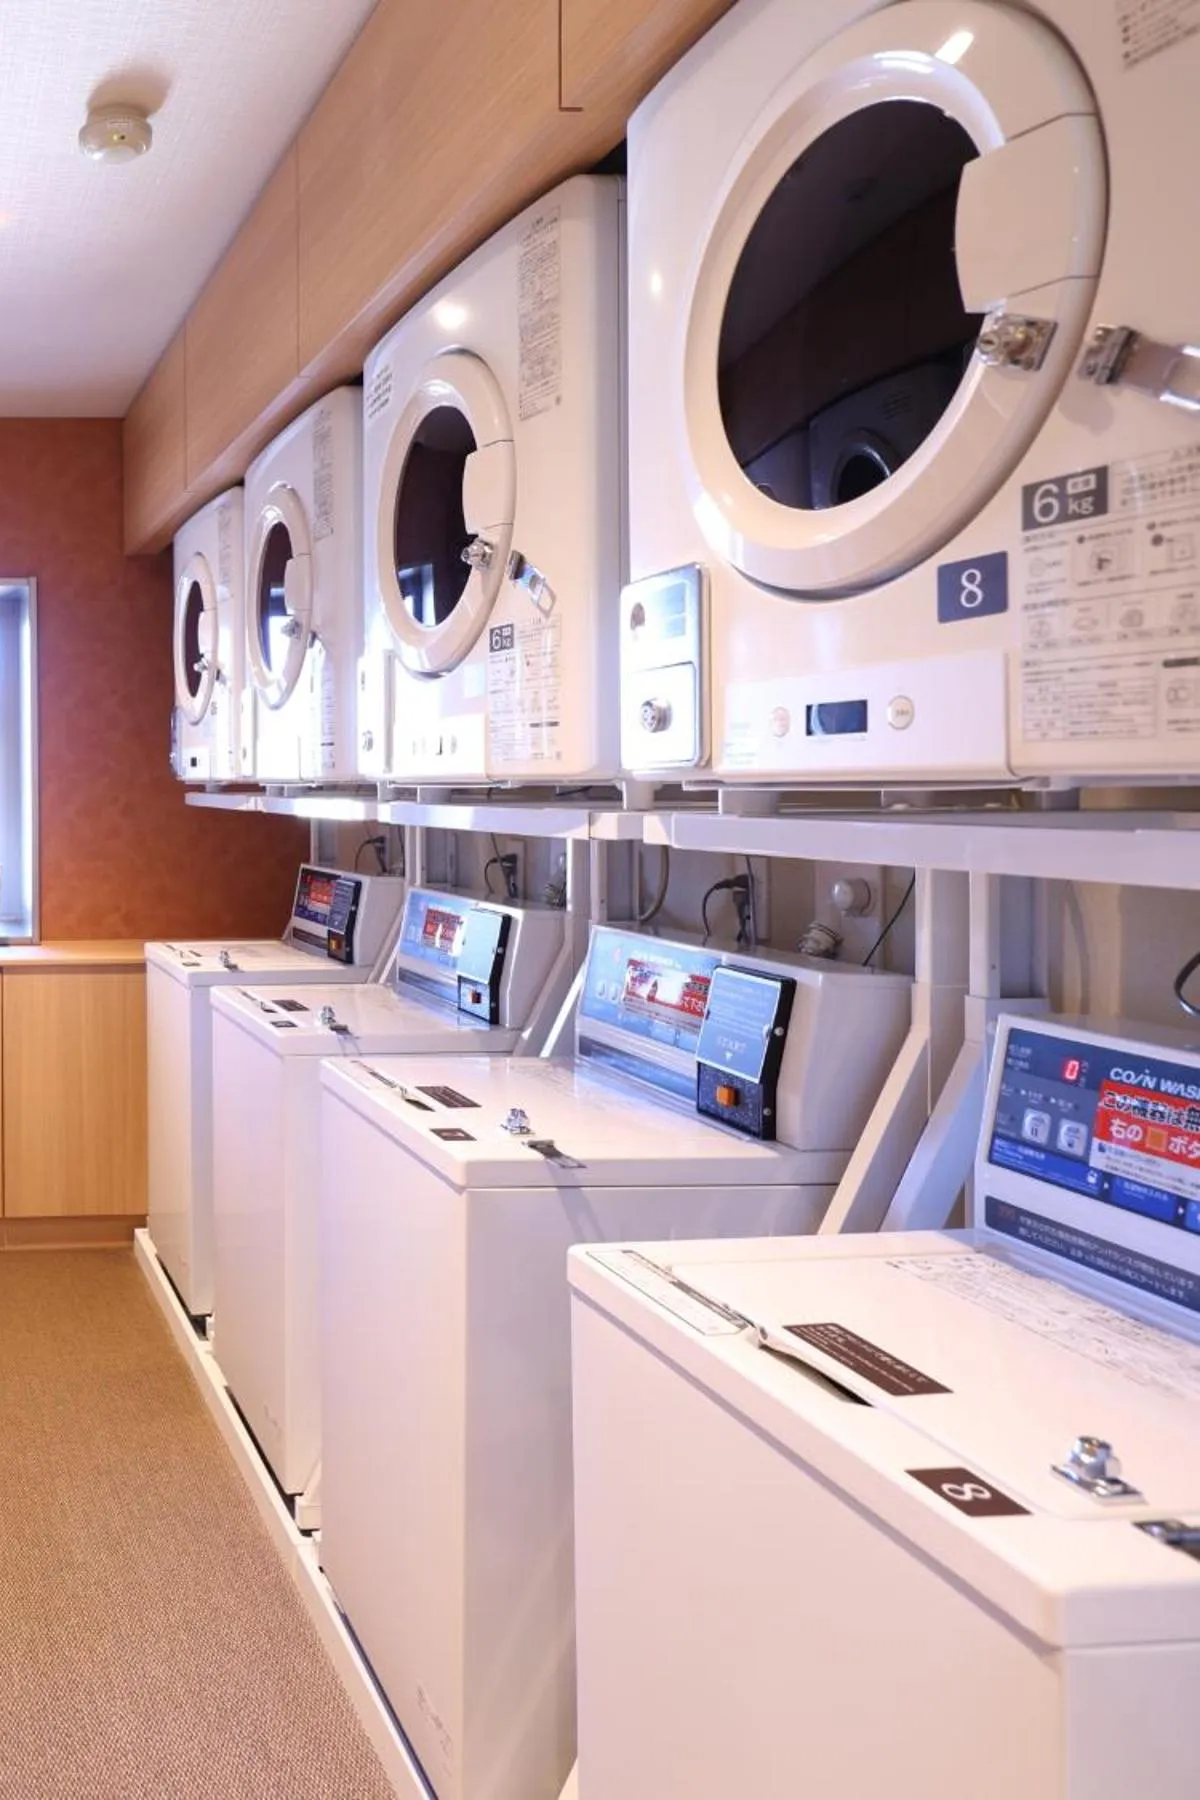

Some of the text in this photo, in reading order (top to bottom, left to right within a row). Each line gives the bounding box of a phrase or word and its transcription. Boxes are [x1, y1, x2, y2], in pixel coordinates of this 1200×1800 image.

[1033, 483, 1060, 523] 6
[1068, 497, 1096, 515] kg
[960, 567, 984, 608] 8
[492, 628, 502, 650] 6
[1064, 1059, 1080, 1081] 0
[1160, 1077, 1200, 1102] WAS
[940, 1482, 993, 1502] 8
